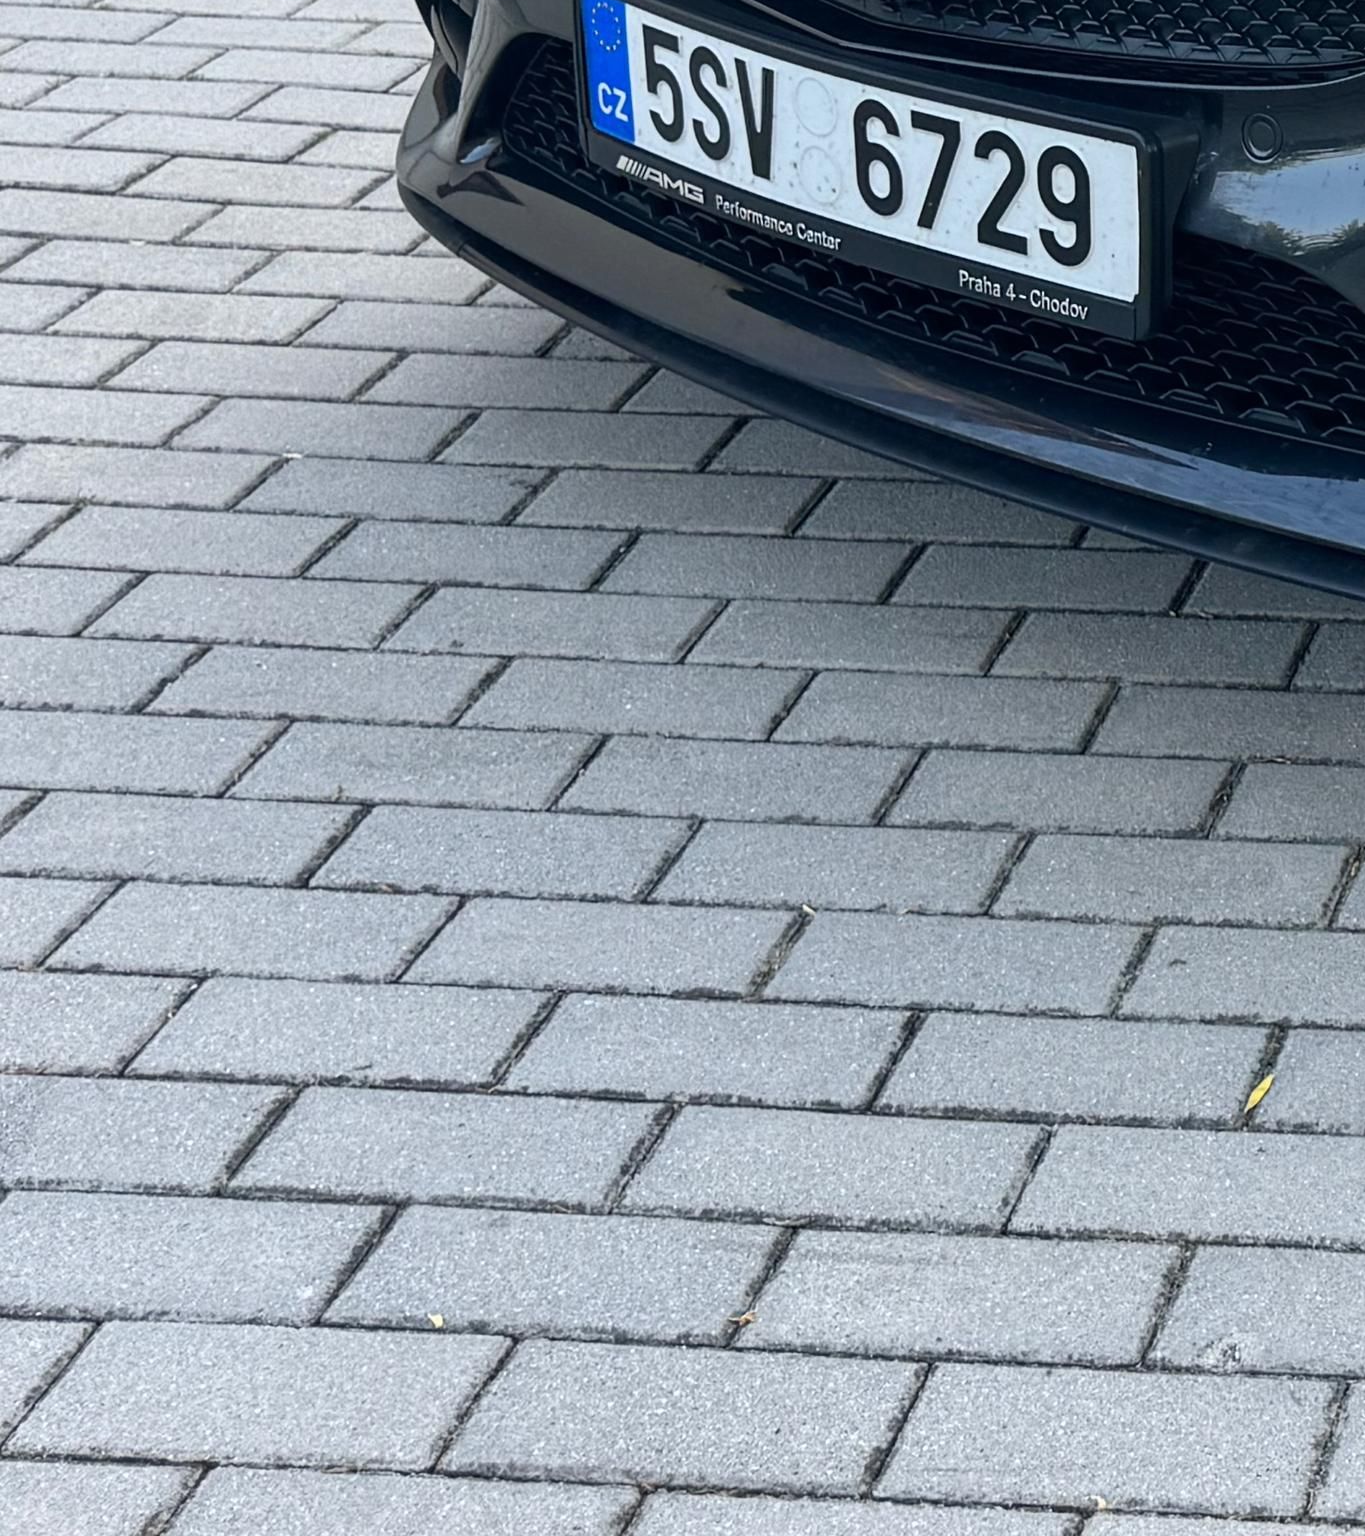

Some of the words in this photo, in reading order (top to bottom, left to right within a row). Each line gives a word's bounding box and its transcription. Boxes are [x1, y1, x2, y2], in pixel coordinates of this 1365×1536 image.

[597, 81, 629, 123] CZ
[641, 24, 776, 182] 5SV
[852, 98, 1093, 268] 6729
[641, 166, 705, 205] AMG
[714, 194, 794, 236] Performance
[796, 222, 842, 252] Center
[958, 269, 1001, 298] Praha
[1005, 282, 1017, 302] 4
[1029, 289, 1089, 321] Chodov
